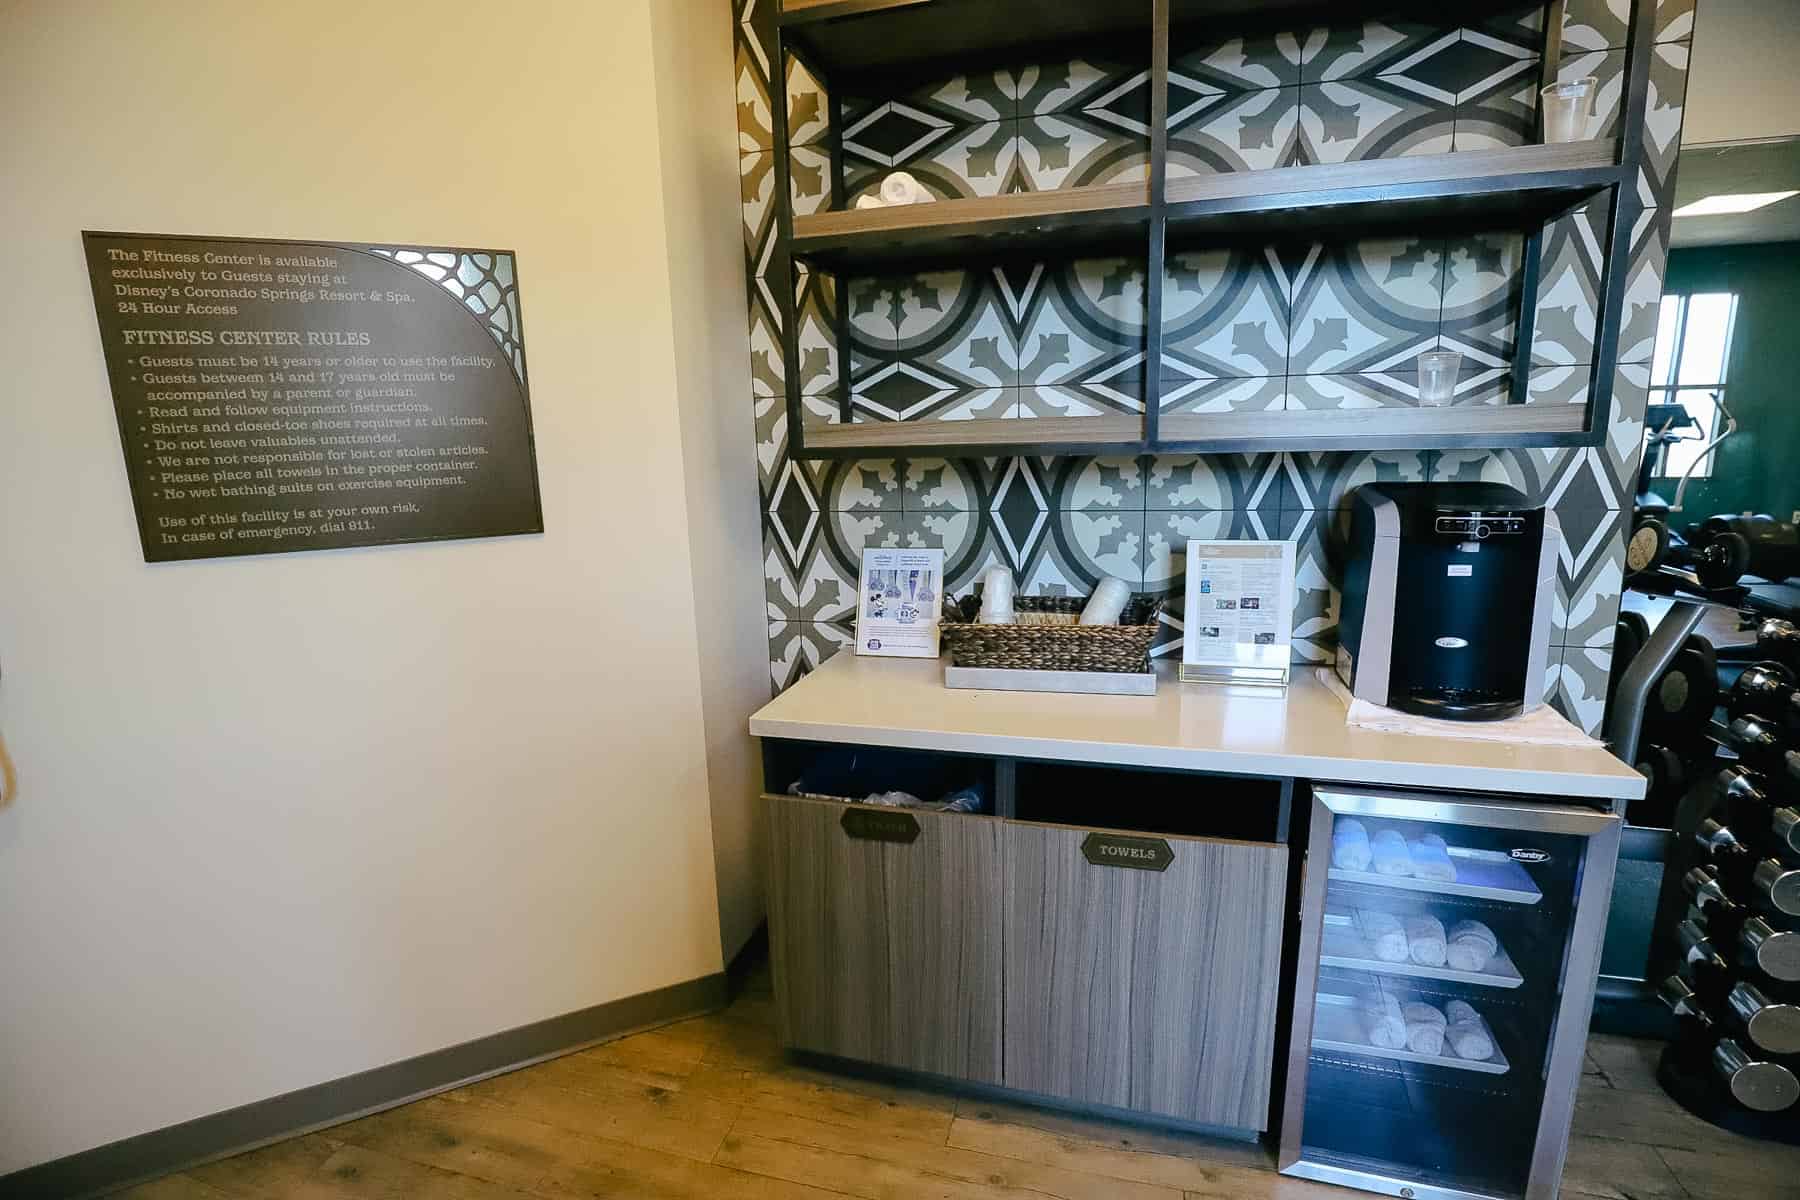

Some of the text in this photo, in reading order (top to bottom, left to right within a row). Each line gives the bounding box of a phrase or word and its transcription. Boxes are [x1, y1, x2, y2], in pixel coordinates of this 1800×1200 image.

[108, 250, 337, 268] The Fitness Center is available
[112, 268, 347, 287] exclusively to Guests staying at
[114, 284, 415, 304] Disney's Coronado Springs Resort & Spa.
[118, 302, 238, 315] 24 Hour Access
[122, 330, 370, 345] FITNESS CENTER RULES
[139, 356, 194, 366] Guests
[198, 357, 236, 366] must
[240, 356, 258, 366] be
[264, 356, 280, 366] 14
[282, 358, 321, 368] years
[326, 358, 338, 366] or
[344, 356, 377, 366] older
[383, 357, 396, 366] to
[400, 358, 423, 366] use
[427, 356, 448, 366] the
[142, 372, 455, 384] Guests between 14 and 17 years old must be
[147, 388, 416, 402] accompanied by a parent or guardian.
[149, 402, 432, 417] Read and follow equipment instructions.
[152, 416, 488, 434] Shirts and closed-toe shoes required at all times.
[154, 434, 400, 450] Do not leave valuables unattended.
[158, 446, 488, 467] We are not responsible for lost or stolen articles.
[161, 460, 478, 483] Please place all towels in the proper container.
[164, 475, 466, 500] No wet bathing suits on exercise equipment.
[158, 516, 186, 528] Use
[192, 514, 207, 526] of
[210, 512, 238, 524] this
[242, 510, 290, 522] facility
[293, 510, 305, 518] is
[310, 508, 323, 518] at
[327, 507, 356, 520] your
[360, 505, 390, 514] own
[161, 533, 177, 544] In
[182, 532, 216, 542] case
[220, 528, 234, 540] of
[320, 522, 345, 532] dial
[348, 520, 376, 531] 911.
[1099, 844, 1156, 860] TOWELS
